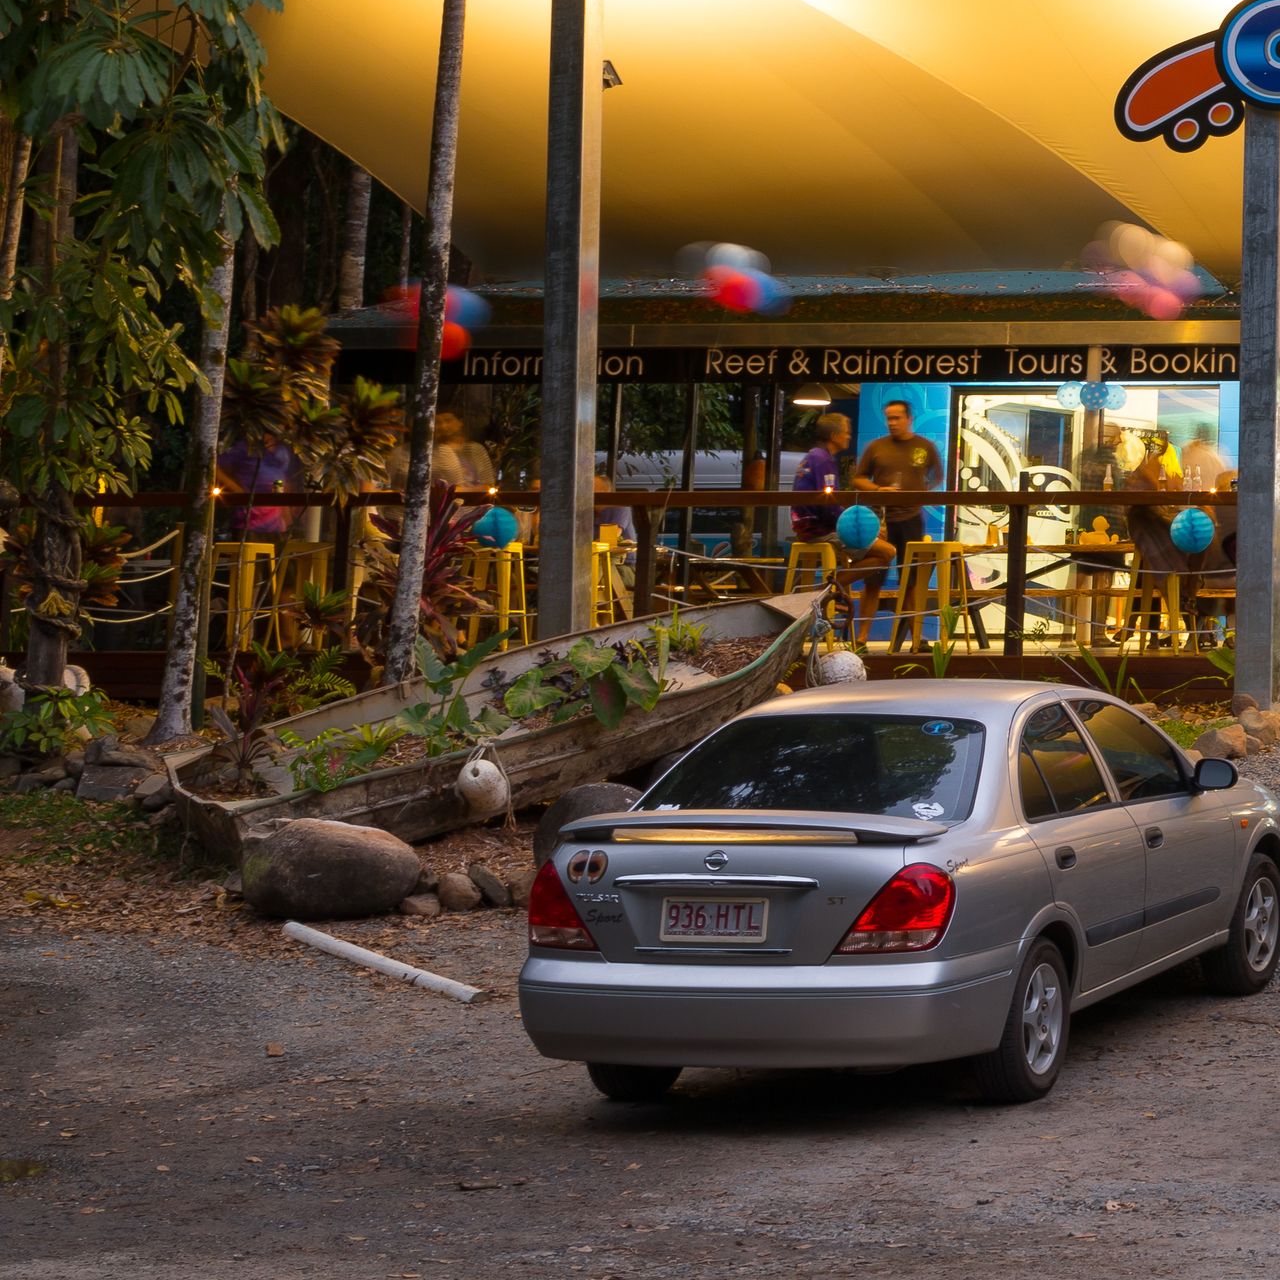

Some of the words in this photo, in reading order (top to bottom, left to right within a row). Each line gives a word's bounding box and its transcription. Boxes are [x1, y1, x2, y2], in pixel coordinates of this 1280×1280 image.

[463, 350, 644, 376] Inforion
[706, 349, 778, 375] Reef
[789, 349, 811, 375] &
[823, 349, 982, 376] Rainforest
[1005, 349, 1083, 375] Tours
[1100, 348, 1118, 375] &
[1131, 348, 1237, 375] Bookin
[827, 896, 847, 905] ST
[585, 909, 623, 925] Sport
